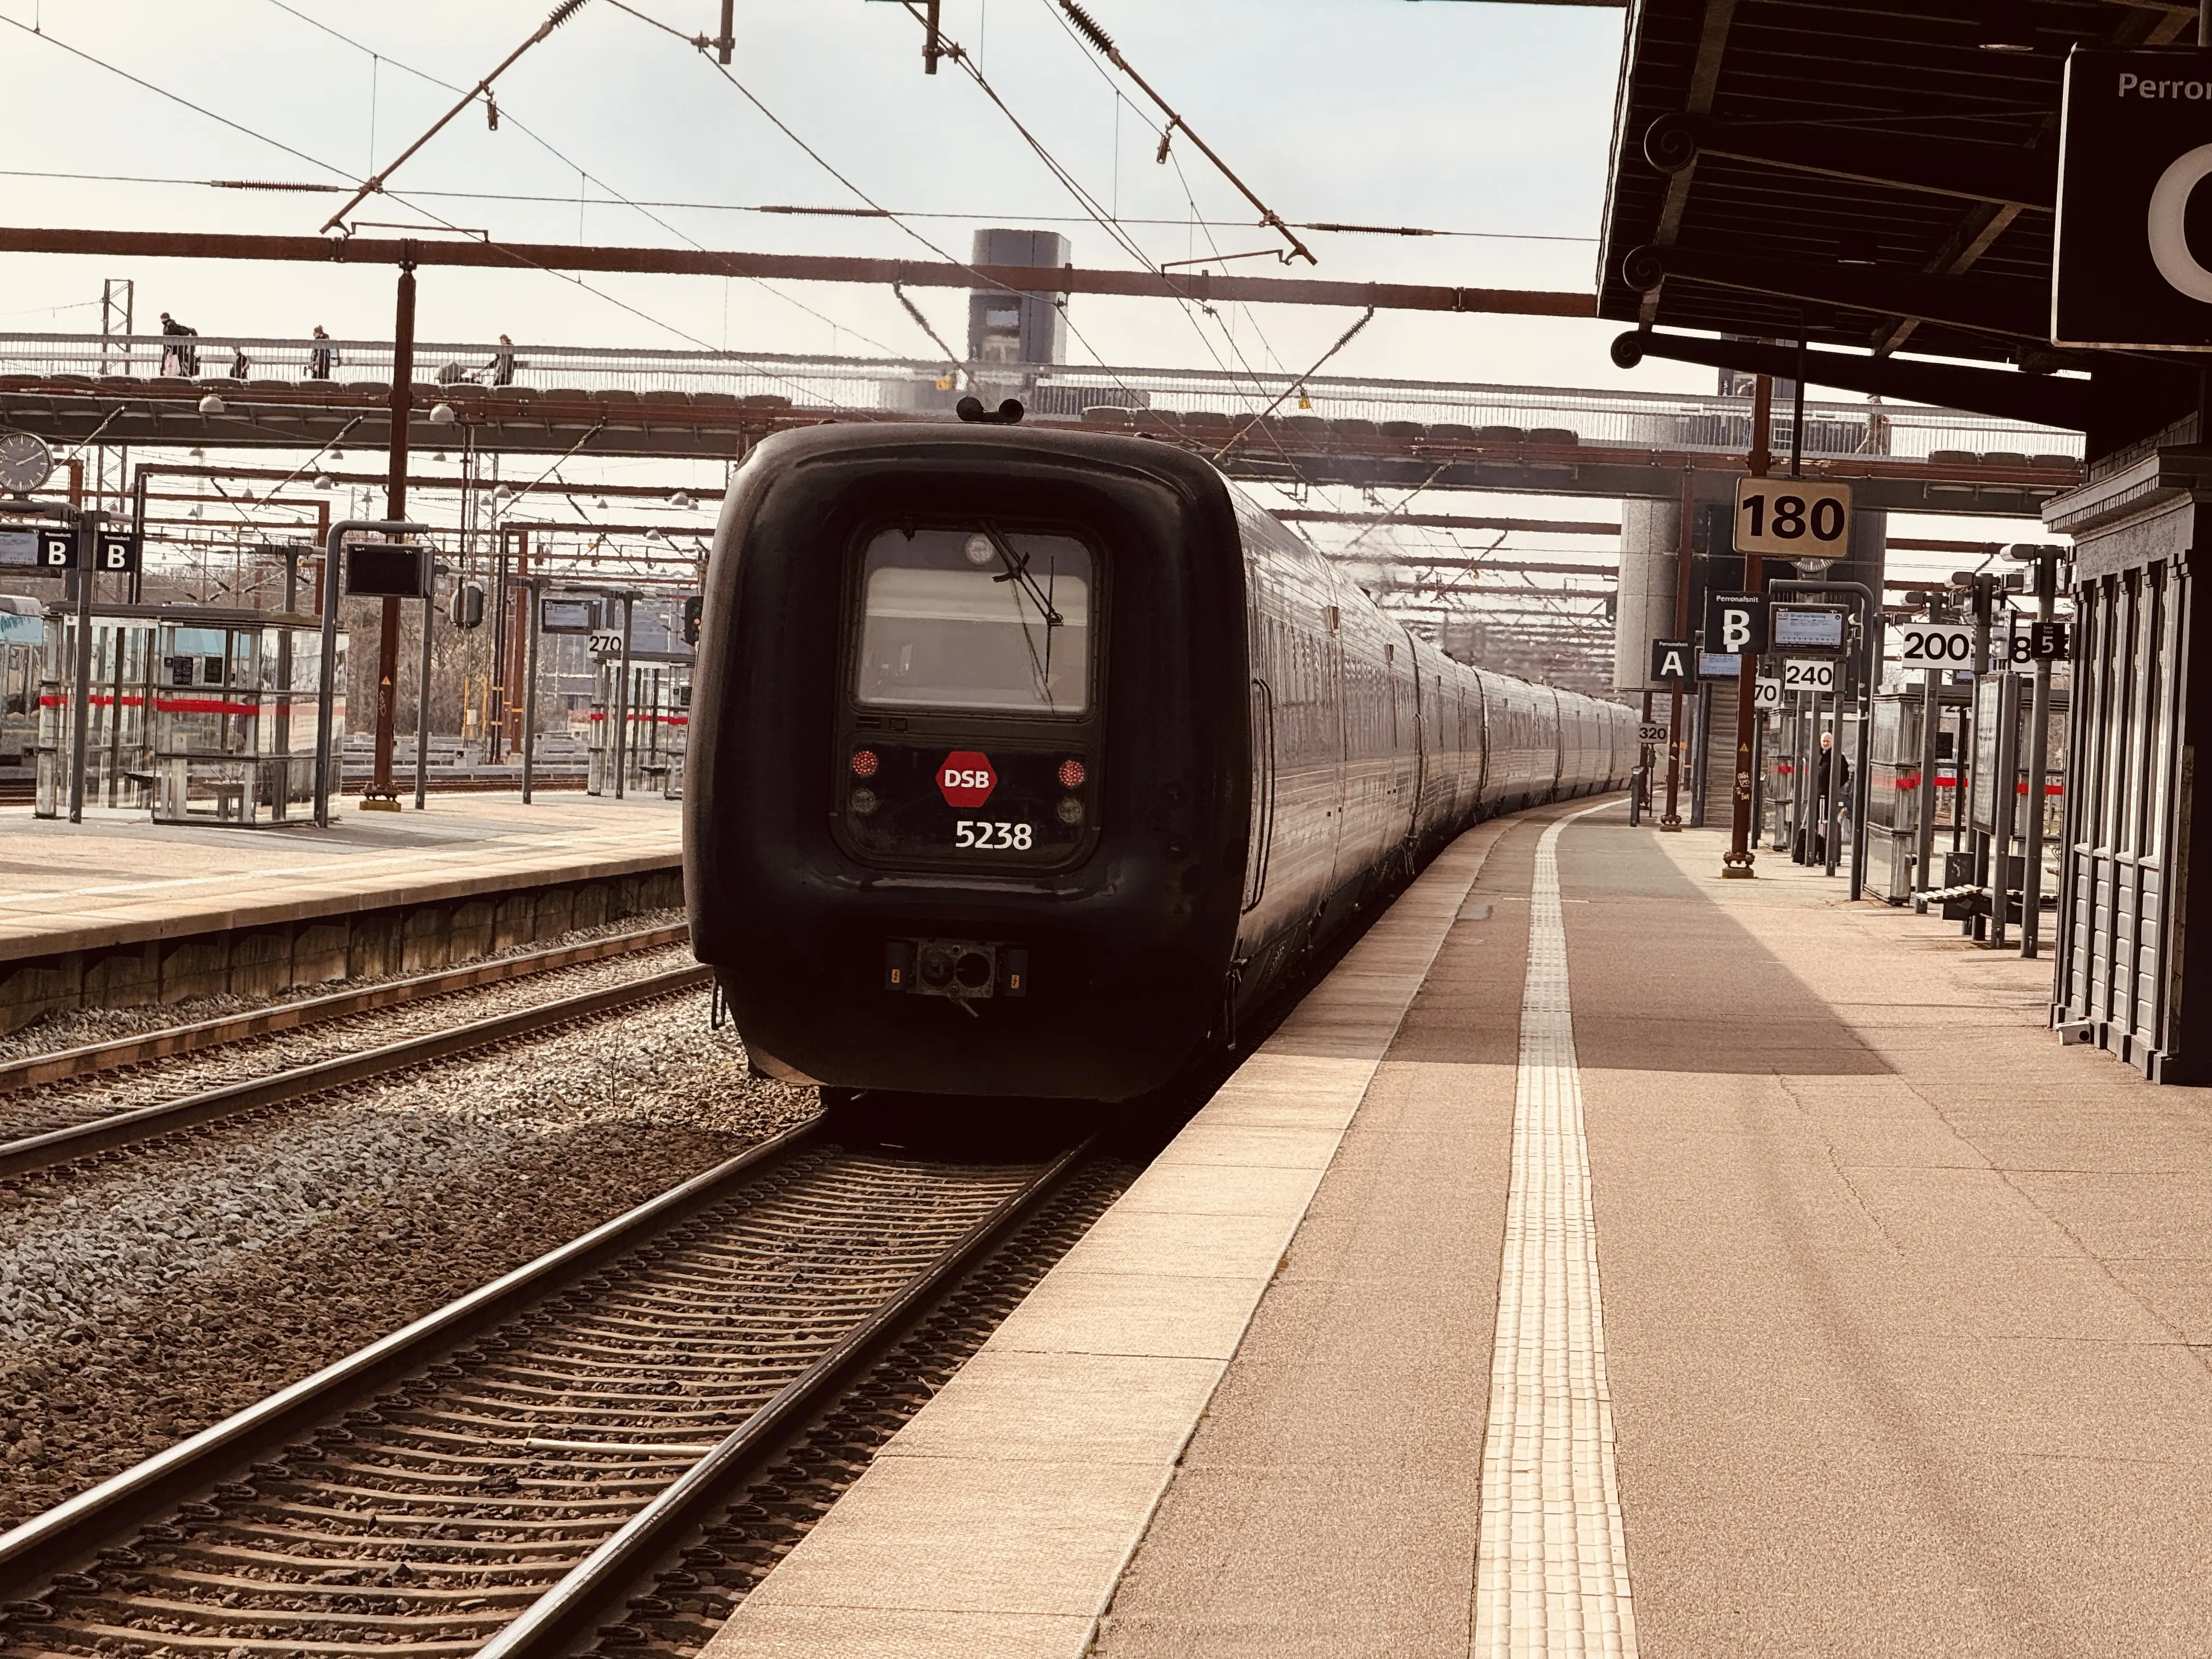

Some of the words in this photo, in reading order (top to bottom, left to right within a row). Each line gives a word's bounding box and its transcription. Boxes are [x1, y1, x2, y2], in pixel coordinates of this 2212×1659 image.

[1742, 494, 1845, 541] 180
[48, 541, 66, 565] B
[107, 544, 125, 568] B
[1716, 595, 1759, 603] Perronafsnit
[1723, 610, 1751, 645] B
[589, 635, 622, 651] 270
[1904, 632, 1970, 661] 200
[2041, 636, 2053, 653] 5
[1660, 651, 1684, 676] A
[1786, 665, 1832, 685] 240
[1639, 727, 1667, 740] 320
[945, 770, 989, 788] DSB
[955, 821, 1032, 850] 5238
